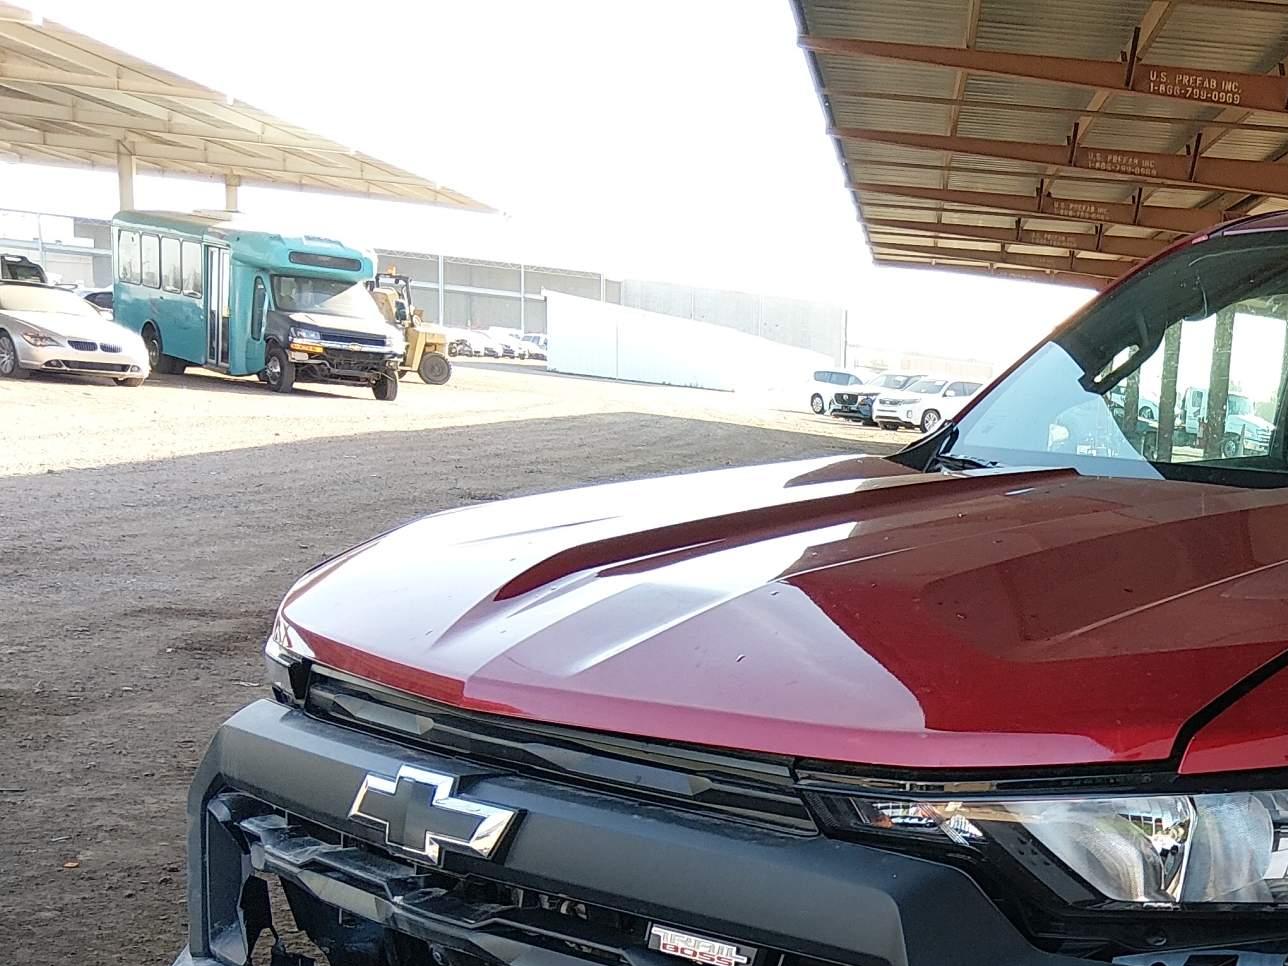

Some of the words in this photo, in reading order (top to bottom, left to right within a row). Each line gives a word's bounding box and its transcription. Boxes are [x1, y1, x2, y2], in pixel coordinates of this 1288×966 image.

[1149, 70, 1170, 83] U.S.
[1175, 74, 1217, 89] PREFAB
[651, 926, 748, 964] TRAIL
